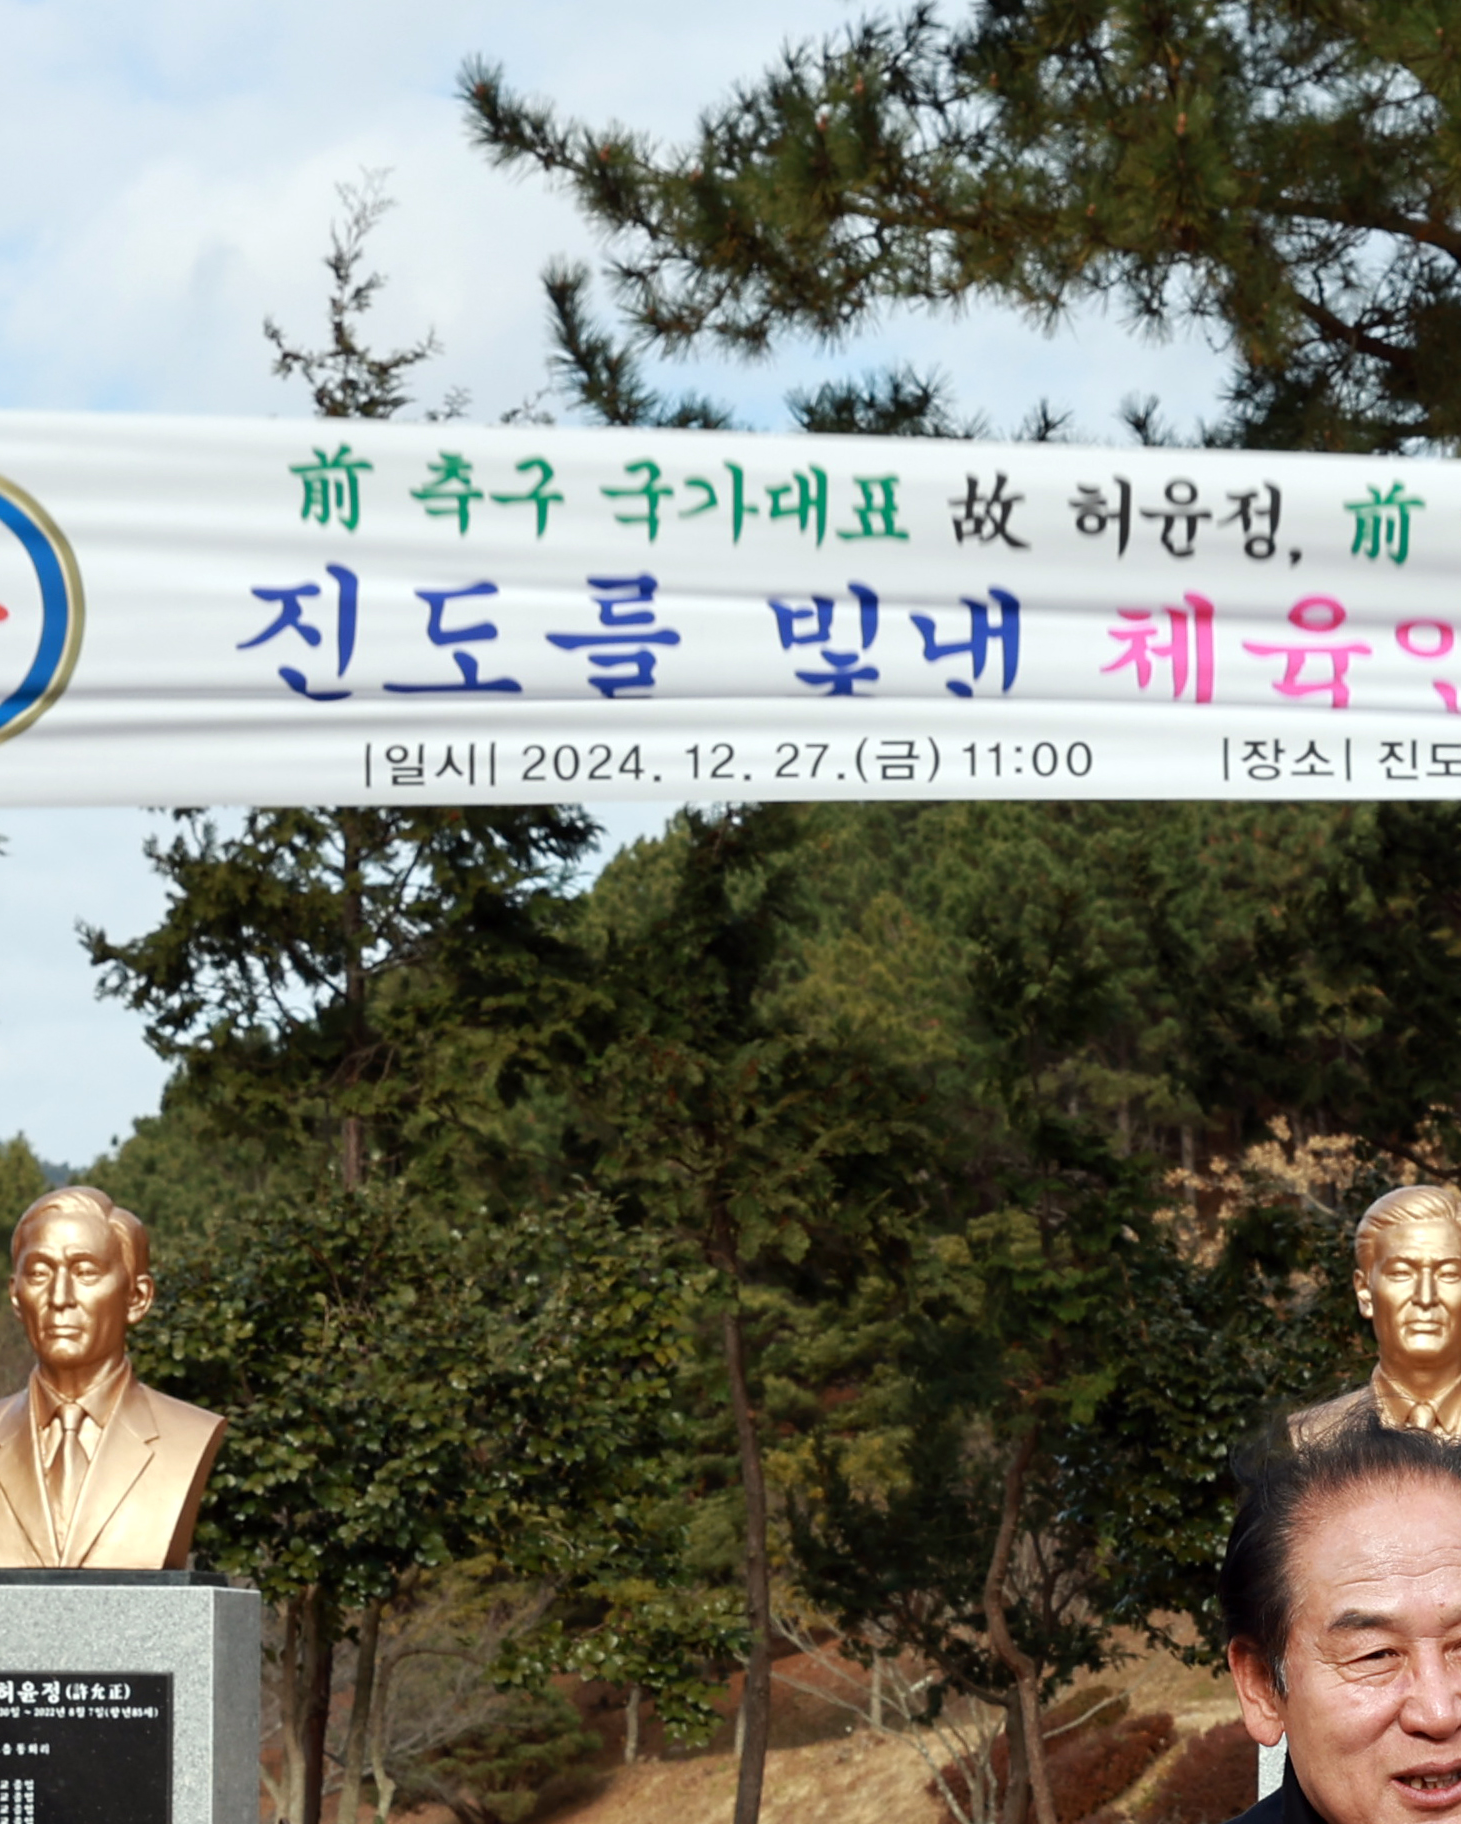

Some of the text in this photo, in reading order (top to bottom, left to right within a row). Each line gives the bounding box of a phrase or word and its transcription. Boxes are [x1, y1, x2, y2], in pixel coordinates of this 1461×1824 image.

[289, 444, 373, 533] 前
[410, 452, 564, 538] 축구
[601, 459, 910, 548] 국가대표
[949, 473, 1030, 550] 故
[1069, 477, 1303, 568] 허윤정,
[1344, 482, 1425, 568] 前
[236, 563, 681, 702] 진도를
[767, 581, 1022, 699] 빛낸
[522, 745, 661, 782] 2024.
[686, 743, 751, 781] 12.
[776, 737, 940, 782] 27.(금)
[963, 742, 1092, 777] 11:00
